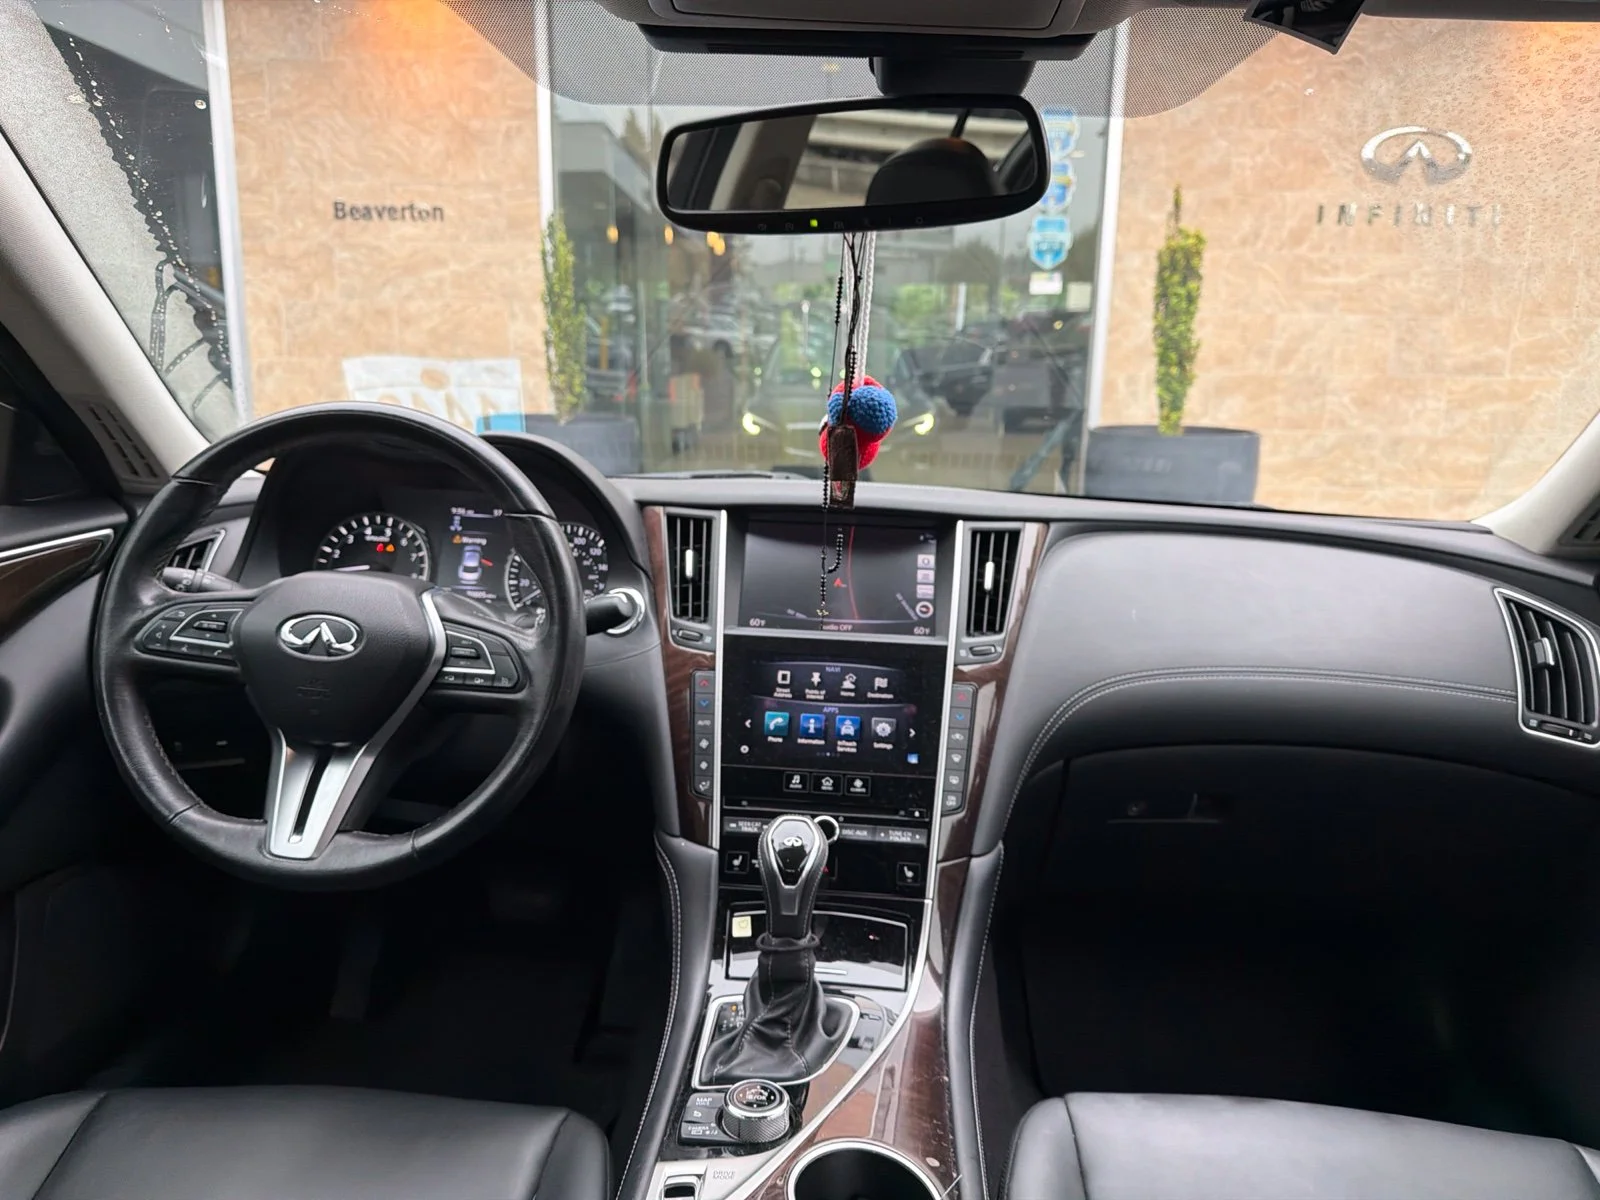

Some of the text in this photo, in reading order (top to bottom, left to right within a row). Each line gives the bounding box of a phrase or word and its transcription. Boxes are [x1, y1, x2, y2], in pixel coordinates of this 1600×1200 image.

[334, 201, 444, 221] Beaverton
[1316, 202, 1501, 225] INFINITI
[462, 536, 487, 545] Warning
[873, 742, 893, 750] Settings
